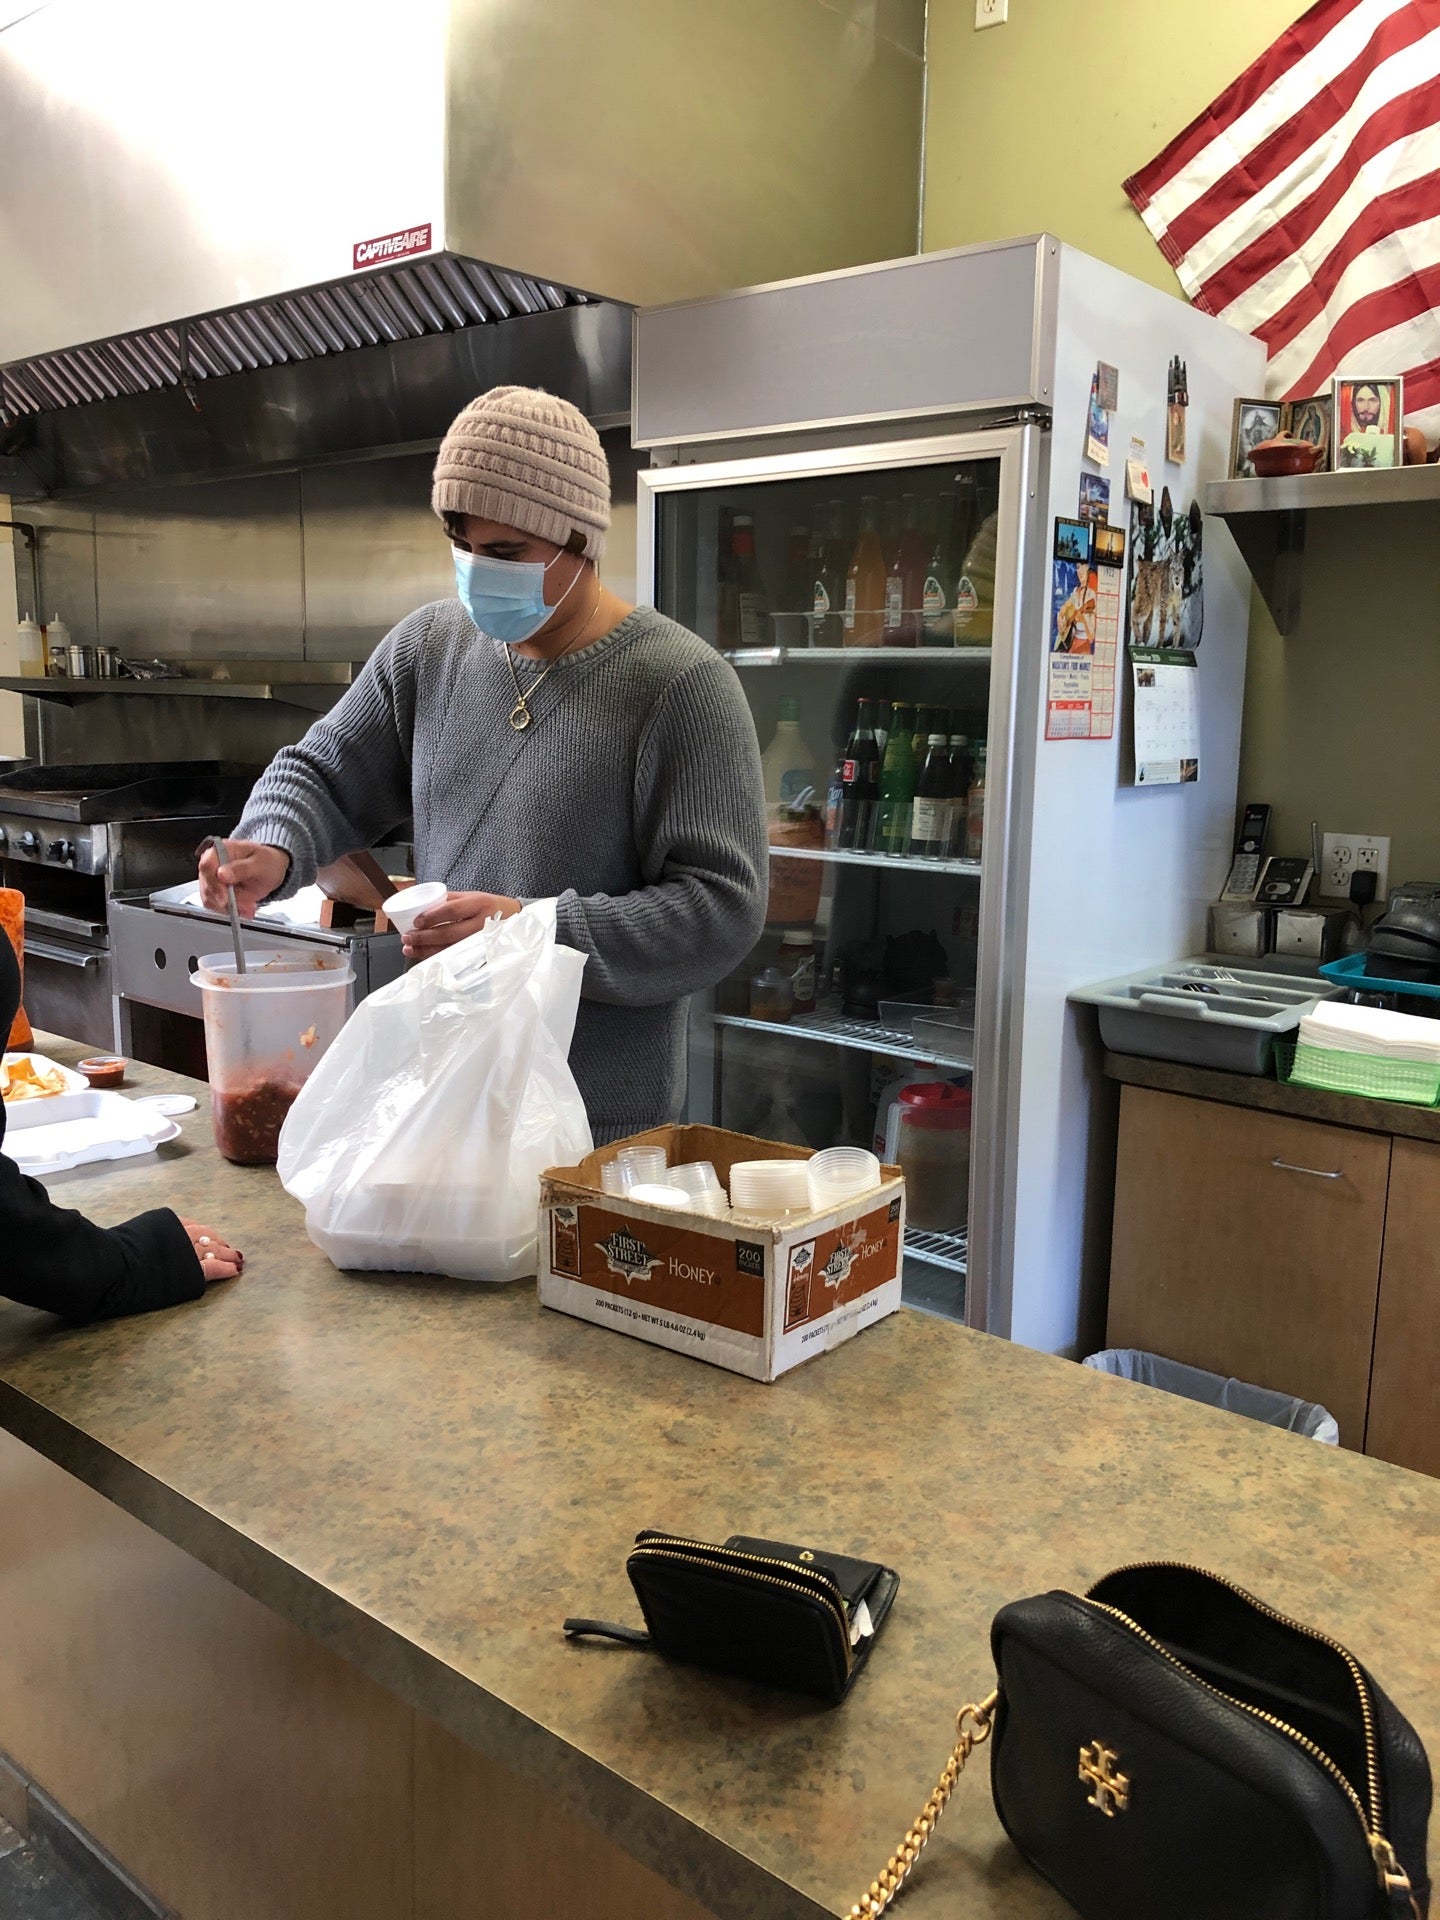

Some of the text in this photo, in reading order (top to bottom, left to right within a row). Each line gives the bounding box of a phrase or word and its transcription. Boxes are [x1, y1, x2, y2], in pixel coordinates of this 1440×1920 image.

[610, 1232, 645, 1252] FIRST
[860, 1238, 885, 1261] HONEY
[607, 1243, 649, 1266] STREET
[738, 1247, 761, 1263] 200
[830, 1247, 850, 1264] FIRST
[668, 1256, 715, 1285] HONEY
[595, 1298, 605, 1308] 200
[604, 1301, 624, 1314] PACKETS
[624, 1306, 632, 1317] (12
[641, 1313, 651, 1323] NET
[651, 1316, 660, 1324] WT
[663, 1320, 670, 1329] LB
[679, 1325, 687, 1334] OZ
[697, 1330, 706, 1341] kg)
